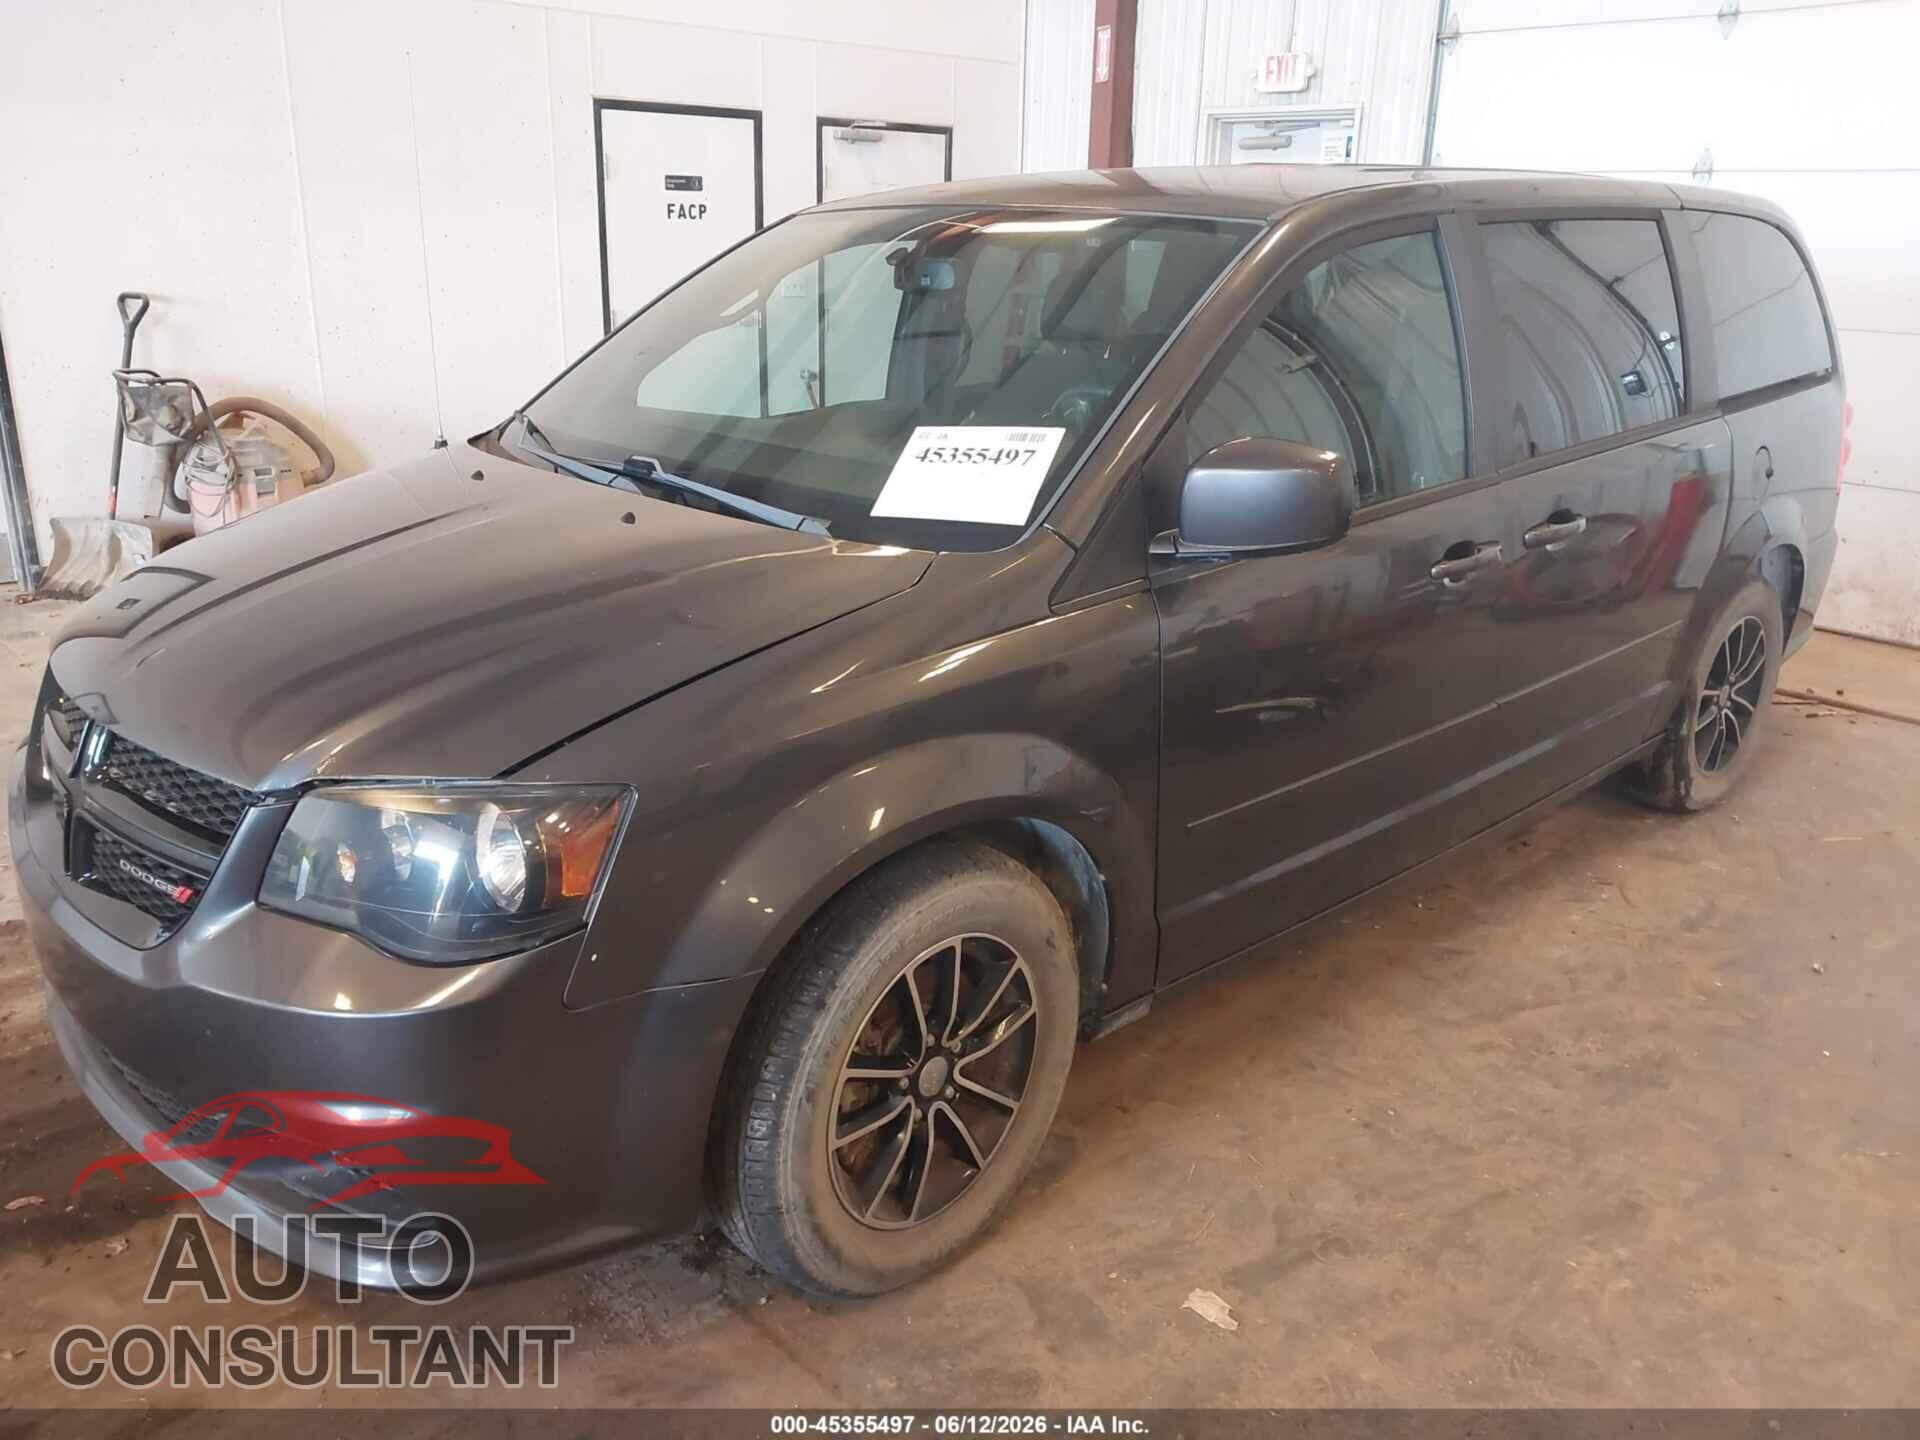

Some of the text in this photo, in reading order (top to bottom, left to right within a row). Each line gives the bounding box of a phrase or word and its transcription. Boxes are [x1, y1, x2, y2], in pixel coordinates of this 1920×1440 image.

[1265, 53, 1299, 83] EXIT
[667, 203, 707, 220] FACP
[915, 447, 1036, 467] 45355497
[120, 859, 179, 901] DODGE
